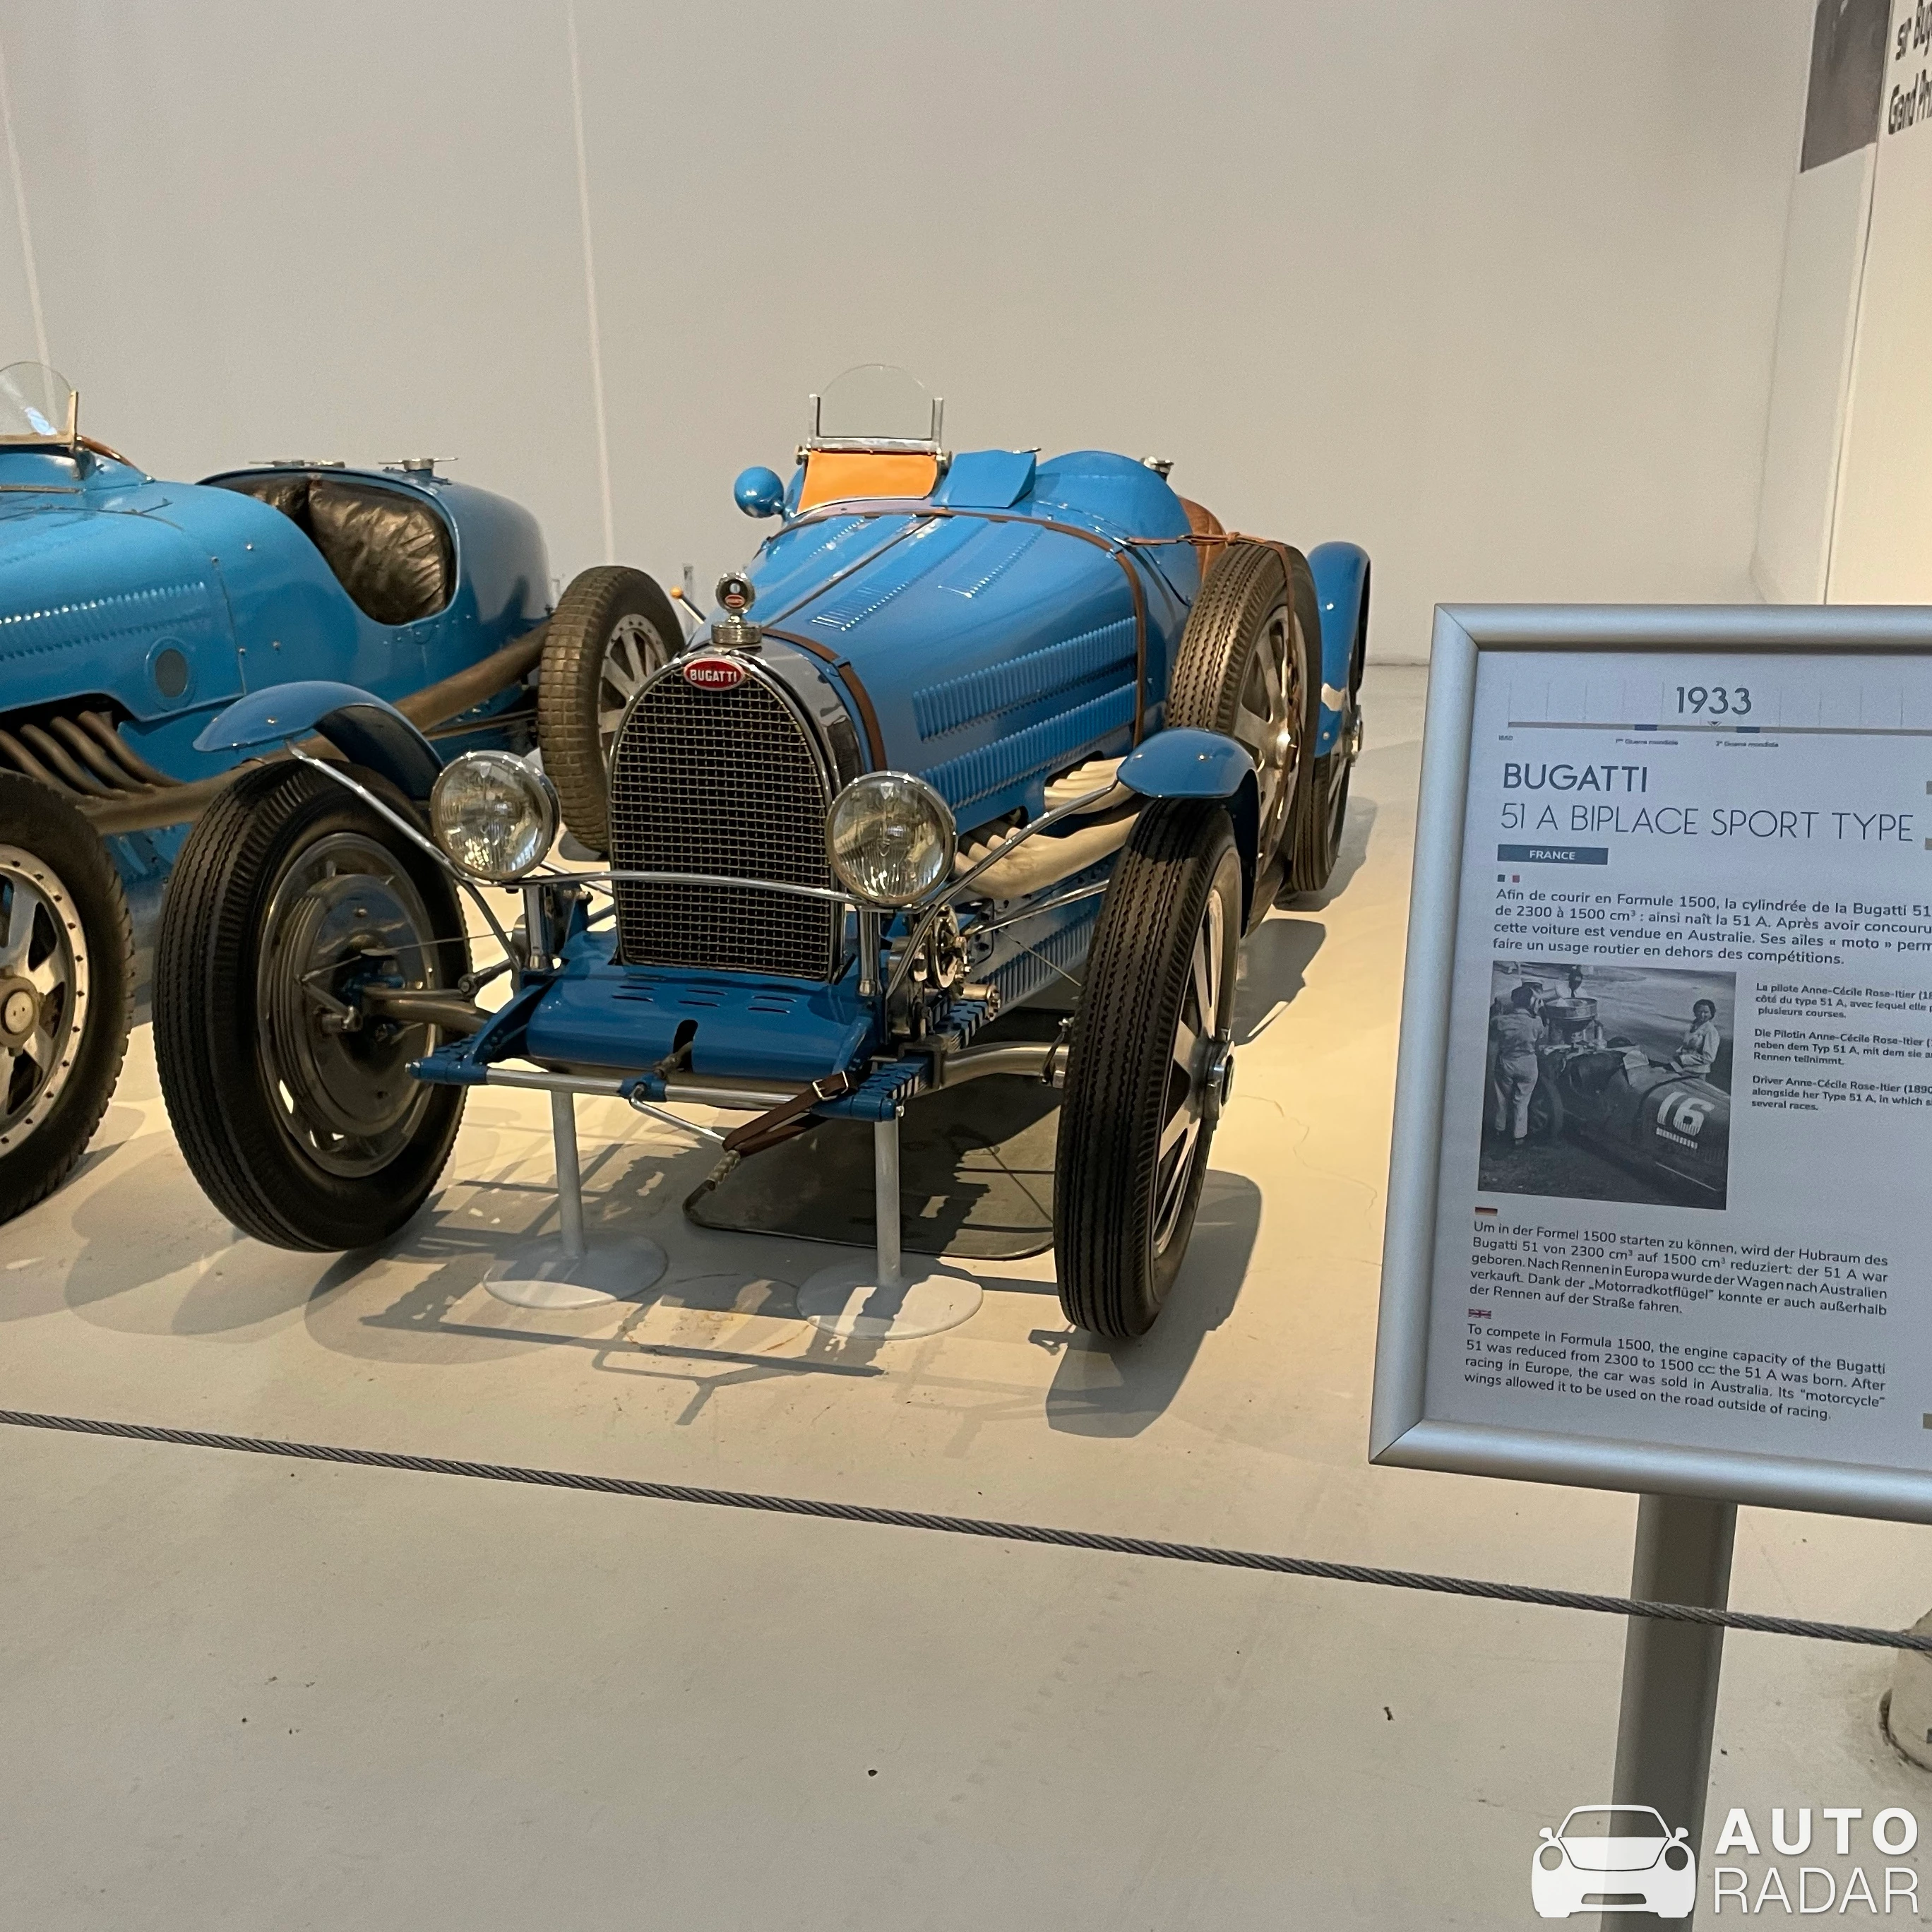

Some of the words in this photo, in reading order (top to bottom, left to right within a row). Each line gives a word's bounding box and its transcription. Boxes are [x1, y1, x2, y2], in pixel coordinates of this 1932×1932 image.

[690, 669, 737, 682] BUGATTI
[1676, 686, 1752, 715] 1933
[1503, 763, 1647, 793] BUGATTI
[1501, 802, 1525, 830] 51
[1536, 804, 1558, 830] A
[1570, 804, 1699, 835] BIPLACE
[1710, 809, 1820, 839] SPORT
[1831, 812, 1914, 842] TYPE
[1530, 850, 1575, 860] FRANCE
[1495, 905, 1512, 916] de
[1516, 905, 1552, 918] 2300
[1570, 907, 1606, 920] 1500
[1648, 911, 1681, 924] ainsi
[1685, 912, 1712, 925] naît
[1716, 913, 1728, 926] la
[1733, 914, 1751, 926] 51
[1755, 915, 1771, 928] A.
[1776, 917, 1819, 930] Après
[1823, 919, 1861, 931] avoir
[1864, 923, 1932, 934] concouru
[1496, 888, 1524, 900] Afin
[1529, 889, 1546, 901] de
[1551, 891, 1591, 903] courir
[1594, 895, 1611, 904] en
[1617, 893, 1674, 907] Formule
[1679, 895, 1719, 910] 1500,
[1724, 897, 1737, 910] la
[1742, 898, 1807, 912] cylindrée
[1812, 900, 1830, 913] de
[1835, 902, 1847, 914] la
[1853, 902, 1907, 918] Bugatti
[1912, 905, 1931, 917] 51
[1493, 922, 1527, 934] cette
[1532, 923, 1580, 936] voiture
[1584, 926, 1606, 937] est
[1609, 927, 1662, 939] vendue
[1666, 931, 1683, 940] en
[1687, 929, 1755, 943] Australie.
[1760, 932, 1787, 945] Ses
[1791, 934, 1824, 947] ailes
[1842, 938, 1880, 949] moto
[1493, 937, 1522, 950] faire
[1527, 942, 1544, 951] un
[1548, 943, 1590, 955] usage
[1593, 943, 1640, 955] routier
[1643, 947, 1661, 956] en
[1664, 945, 1713, 958] dehors
[1717, 947, 1743, 960] des
[1747, 950, 1844, 965] compétitions.
[1657, 1092, 1715, 1136] 16
[1472, 1236, 1517, 1251] Bugatti
[1570, 1245, 1604, 1258] 2300
[1637, 1252, 1659, 1263] auf
[1862, 1272, 1889, 1283] war
[1474, 1220, 1495, 1233] Um
[1498, 1222, 1510, 1234] in
[1513, 1224, 1534, 1236] der
[1537, 1226, 1579, 1240] Formel
[1583, 1230, 1616, 1244] 1500
[1619, 1234, 1664, 1248] starten
[1668, 1239, 1683, 1249] zu
[1687, 1238, 1737, 1255] können,
[1741, 1244, 1770, 1256] wird
[1773, 1246, 1796, 1258] der
[1799, 1248, 1861, 1264] Hubraum
[1864, 1254, 1888, 1266] des
[1471, 1253, 1525, 1268] geboren.
[1527, 1257, 1559, 1270] Nach
[1561, 1260, 1609, 1275] Rennen
[1624, 1265, 1669, 1281] Europa
[1671, 1272, 1712, 1284] wurde
[1736, 1275, 1784, 1291] Wagen
[1786, 1281, 1818, 1293] nach
[1819, 1282, 1888, 1299] Australien
[1528, 1272, 1561, 1287] Dank
[1718, 1289, 1763, 1305] konnte
[1784, 1297, 1815, 1309] auch
[1820, 1301, 1887, 1316] außerhalb
[1493, 1285, 1541, 1301] Rennen
[1592, 1294, 1635, 1309] Straße
[1638, 1299, 1683, 1314] fahren.
[1467, 1323, 1482, 1335] To
[1486, 1328, 1540, 1341] compete
[1544, 1330, 1556, 1342] in
[1561, 1332, 1612, 1348] Formula
[1617, 1338, 1654, 1354] 1500,
[1659, 1342, 1680, 1354] the
[1684, 1346, 1728, 1360] engine
[1732, 1352, 1788, 1367] capacity
[1791, 1355, 1806, 1366] of
[1810, 1356, 1832, 1369] the
[1837, 1358, 1885, 1375] Bugatti
[1516, 1345, 1566, 1359] reduced
[1570, 1349, 1600, 1364] from
[1604, 1353, 1638, 1366] 2300
[1660, 1359, 1694, 1373] 1500
[1719, 1364, 1741, 1377] the
[1813, 1373, 1847, 1388] born.
[1851, 1377, 1886, 1391] After
[1464, 1373, 1502, 1388] wings
[1505, 1376, 1555, 1391] allowed
[1606, 1388, 1636, 1400] used
[1640, 1392, 1657, 1402] on
[1660, 1391, 1681, 1404] the
[1684, 1396, 1714, 1407] road
[1717, 1400, 1766, 1413] outside
[1787, 1406, 1831, 1422] racing.
[1465, 1357, 1503, 1372] racing
[1525, 1361, 1573, 1378] Europe,
[1604, 1372, 1624, 1381] car
[1661, 1376, 1688, 1388] sold
[1710, 1380, 1772, 1397] Australia.
[1778, 1386, 1794, 1399] Its
